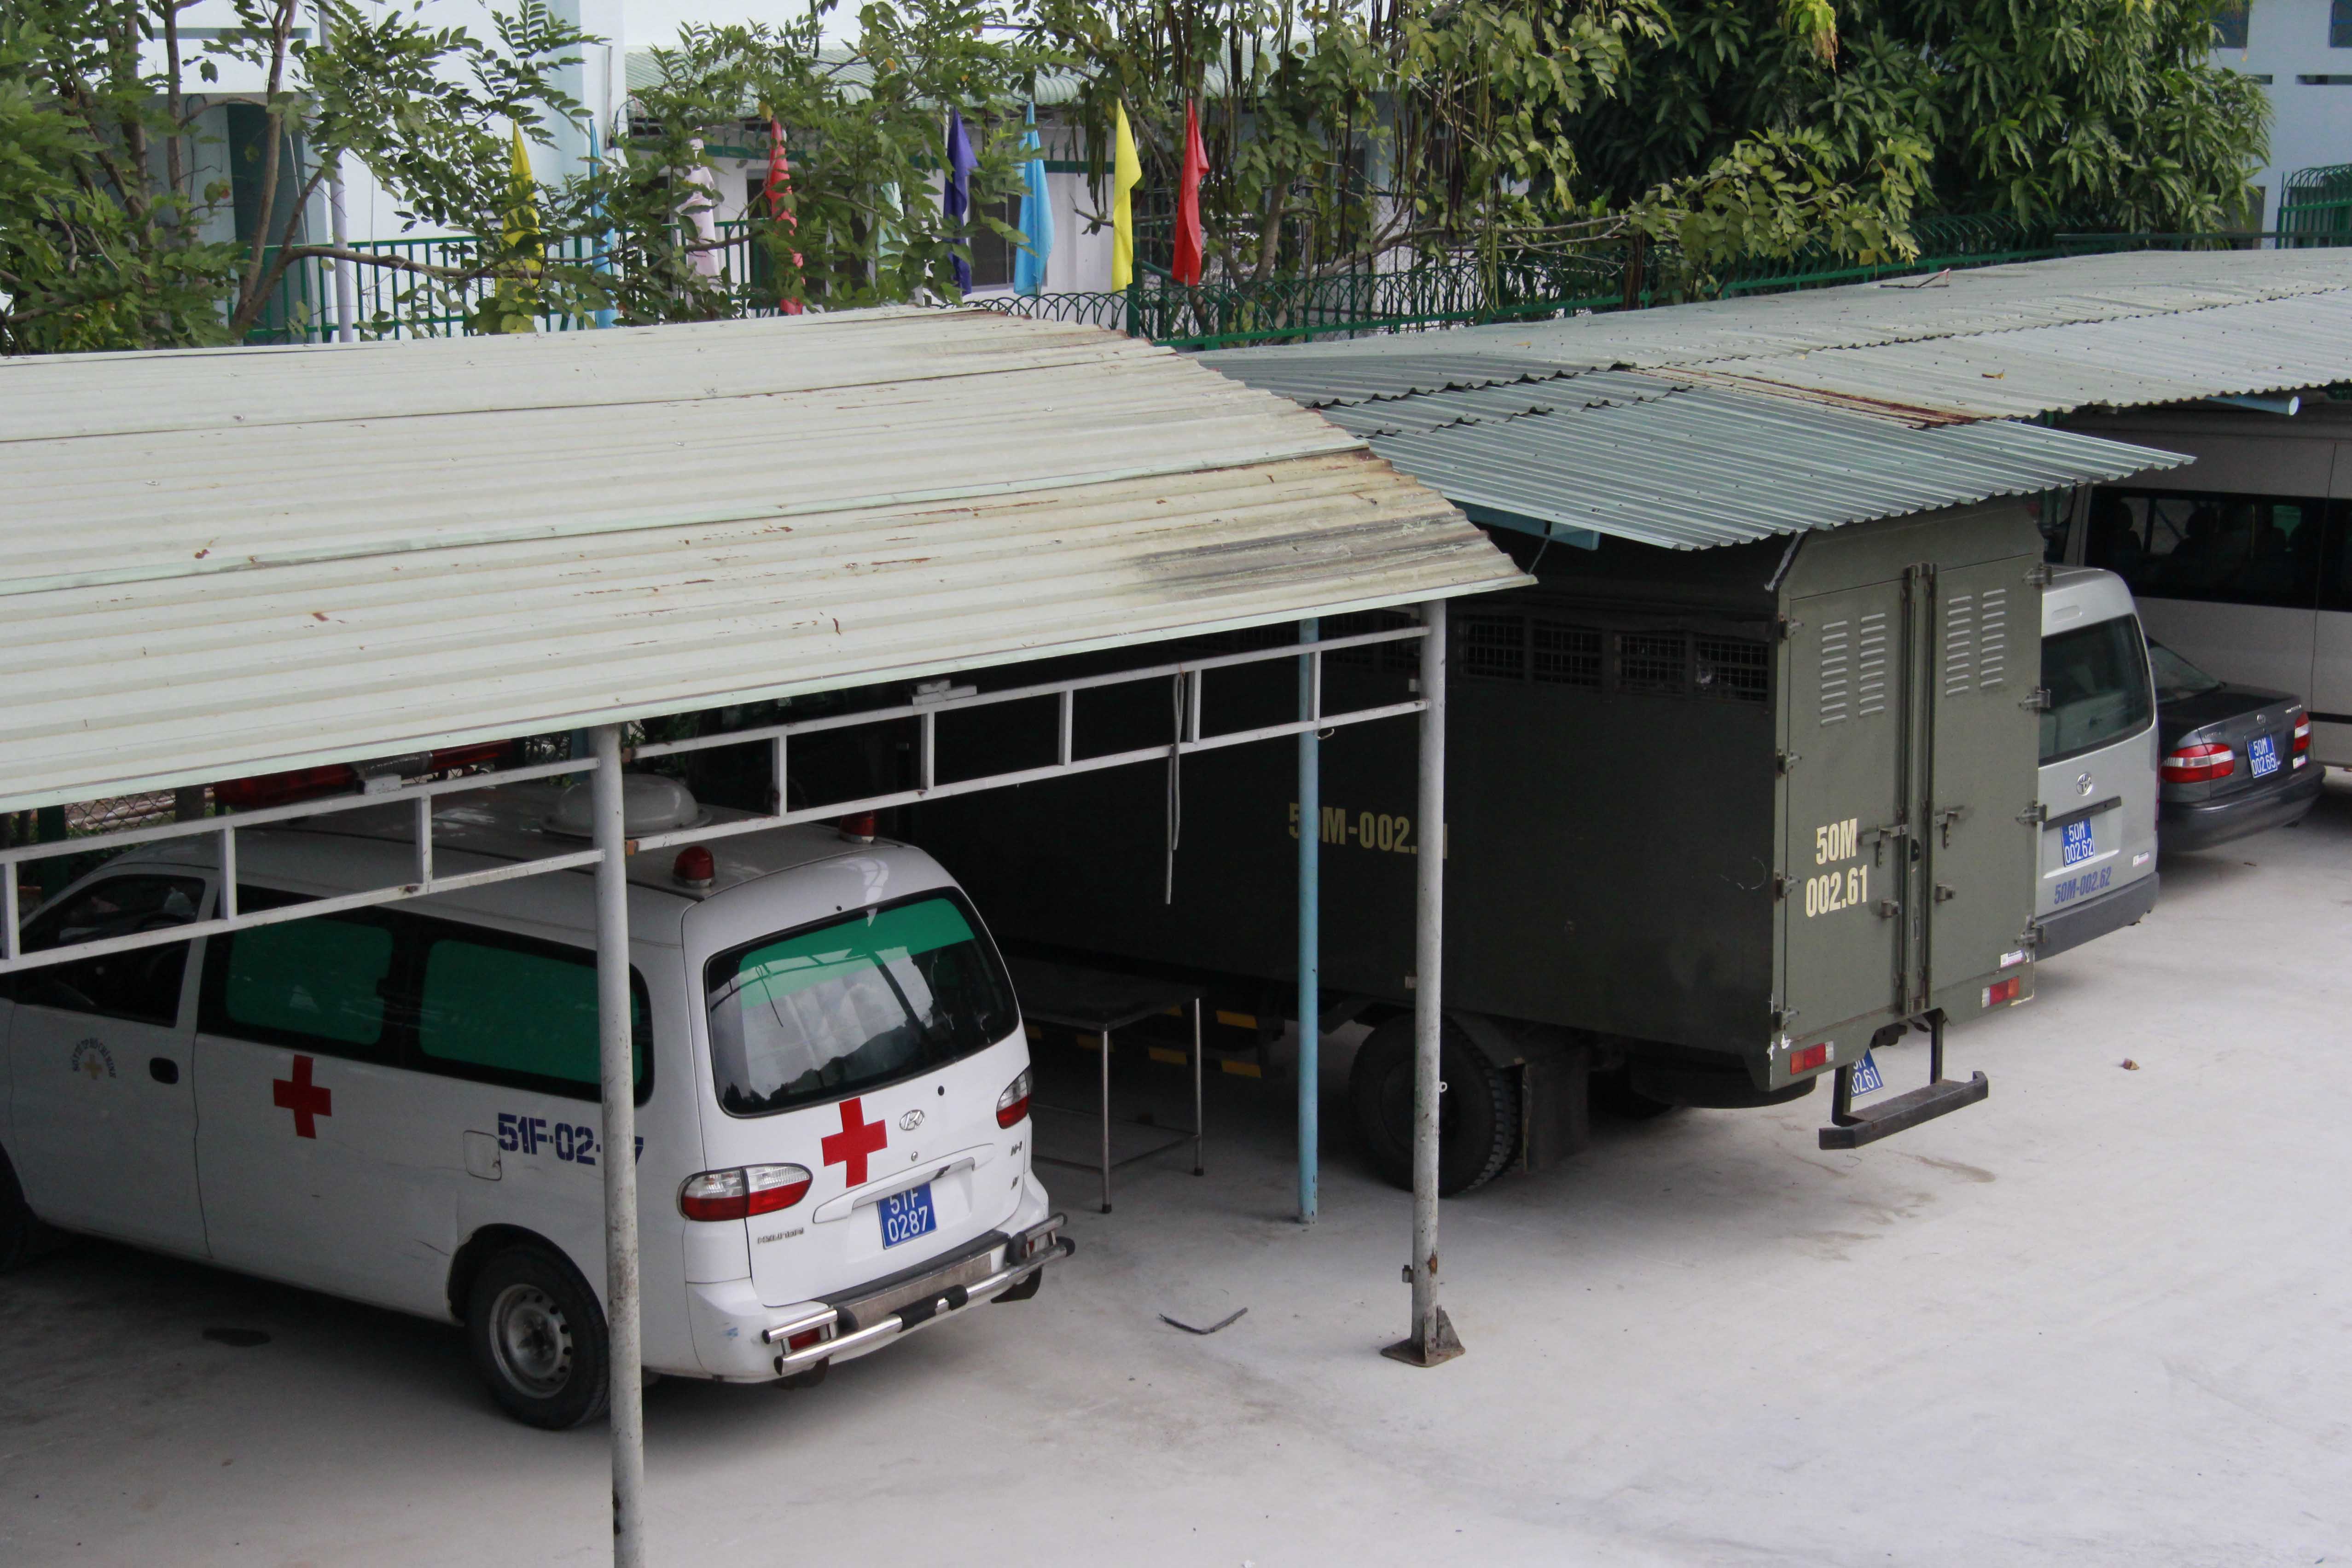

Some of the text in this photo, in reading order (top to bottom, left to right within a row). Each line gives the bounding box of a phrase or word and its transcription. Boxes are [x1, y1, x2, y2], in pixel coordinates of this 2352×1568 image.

[2253, 737, 2268, 757] 50M
[1816, 818, 1857, 865] 50M
[2068, 820, 2085, 842] 50M
[2064, 837, 2094, 864] 002.62
[1806, 865, 1867, 918] 002.61
[2054, 866, 2112, 905] 50M-002.62
[888, 1205, 928, 1242] 0287
